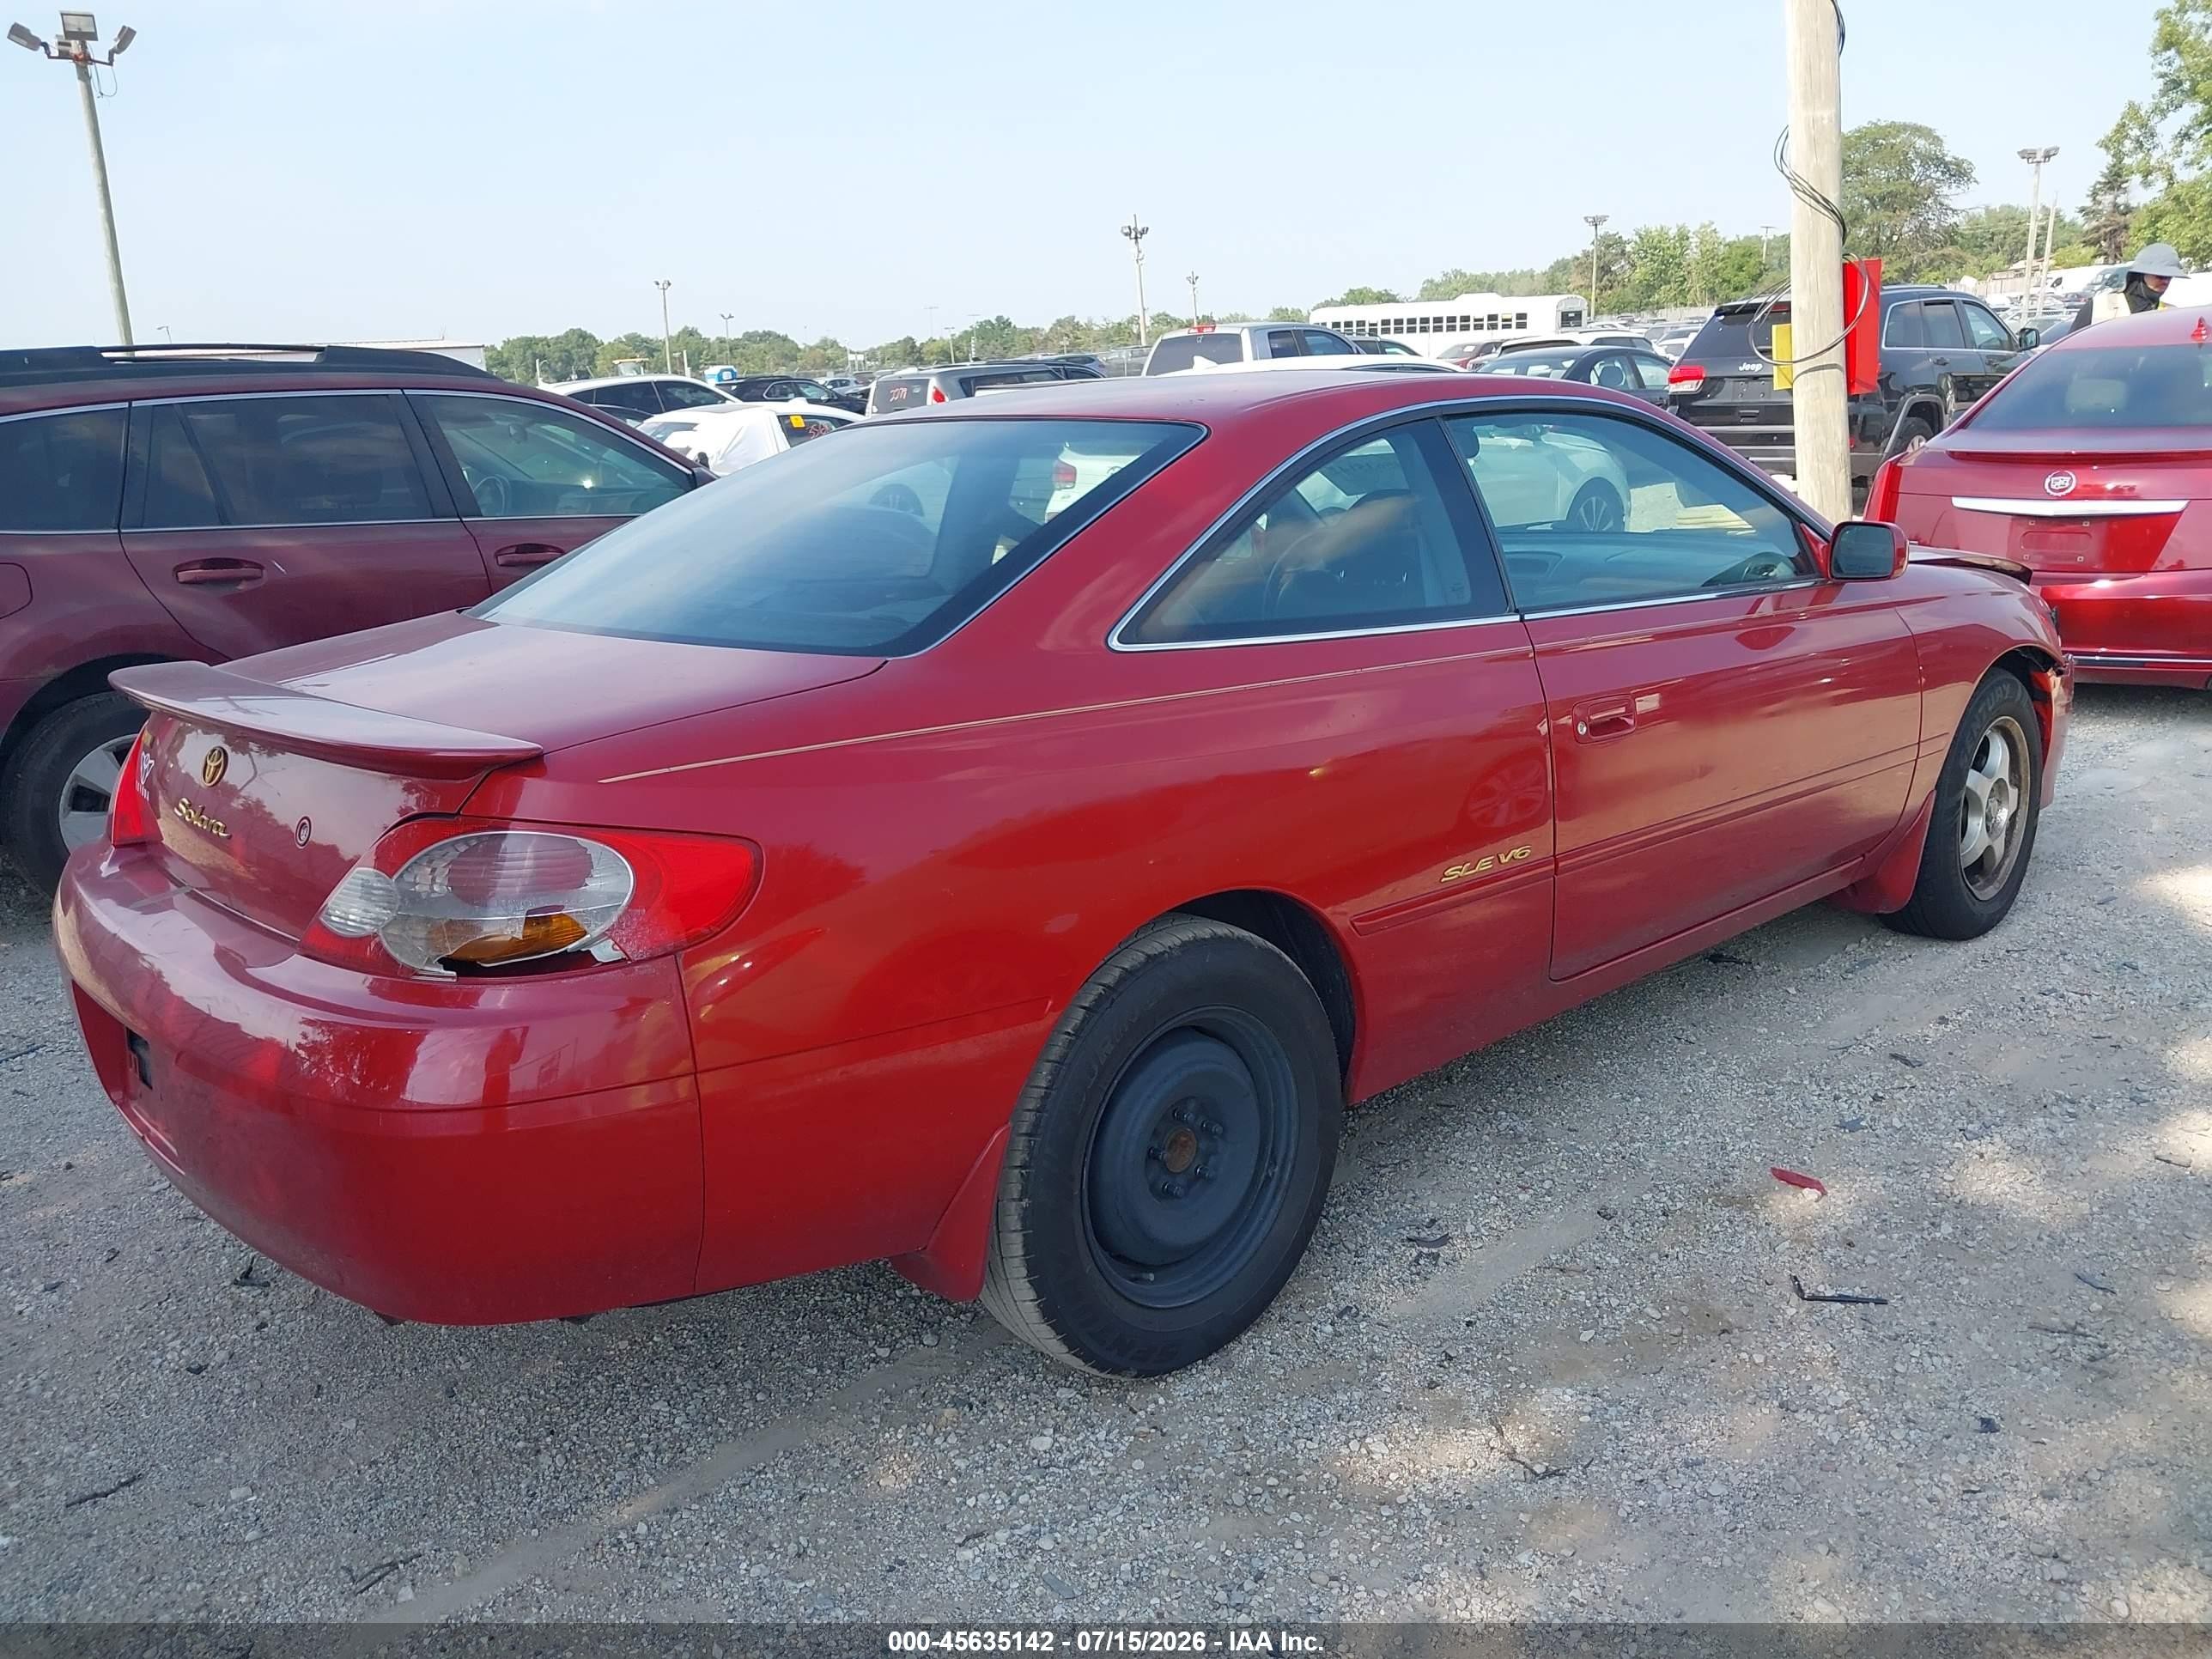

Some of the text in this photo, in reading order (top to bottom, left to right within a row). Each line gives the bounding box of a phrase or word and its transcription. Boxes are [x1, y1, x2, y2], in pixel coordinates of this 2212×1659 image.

[1738, 362, 1763, 372] Jeep
[173, 797, 232, 839] Solara
[1441, 845, 1532, 883] SLE V6
